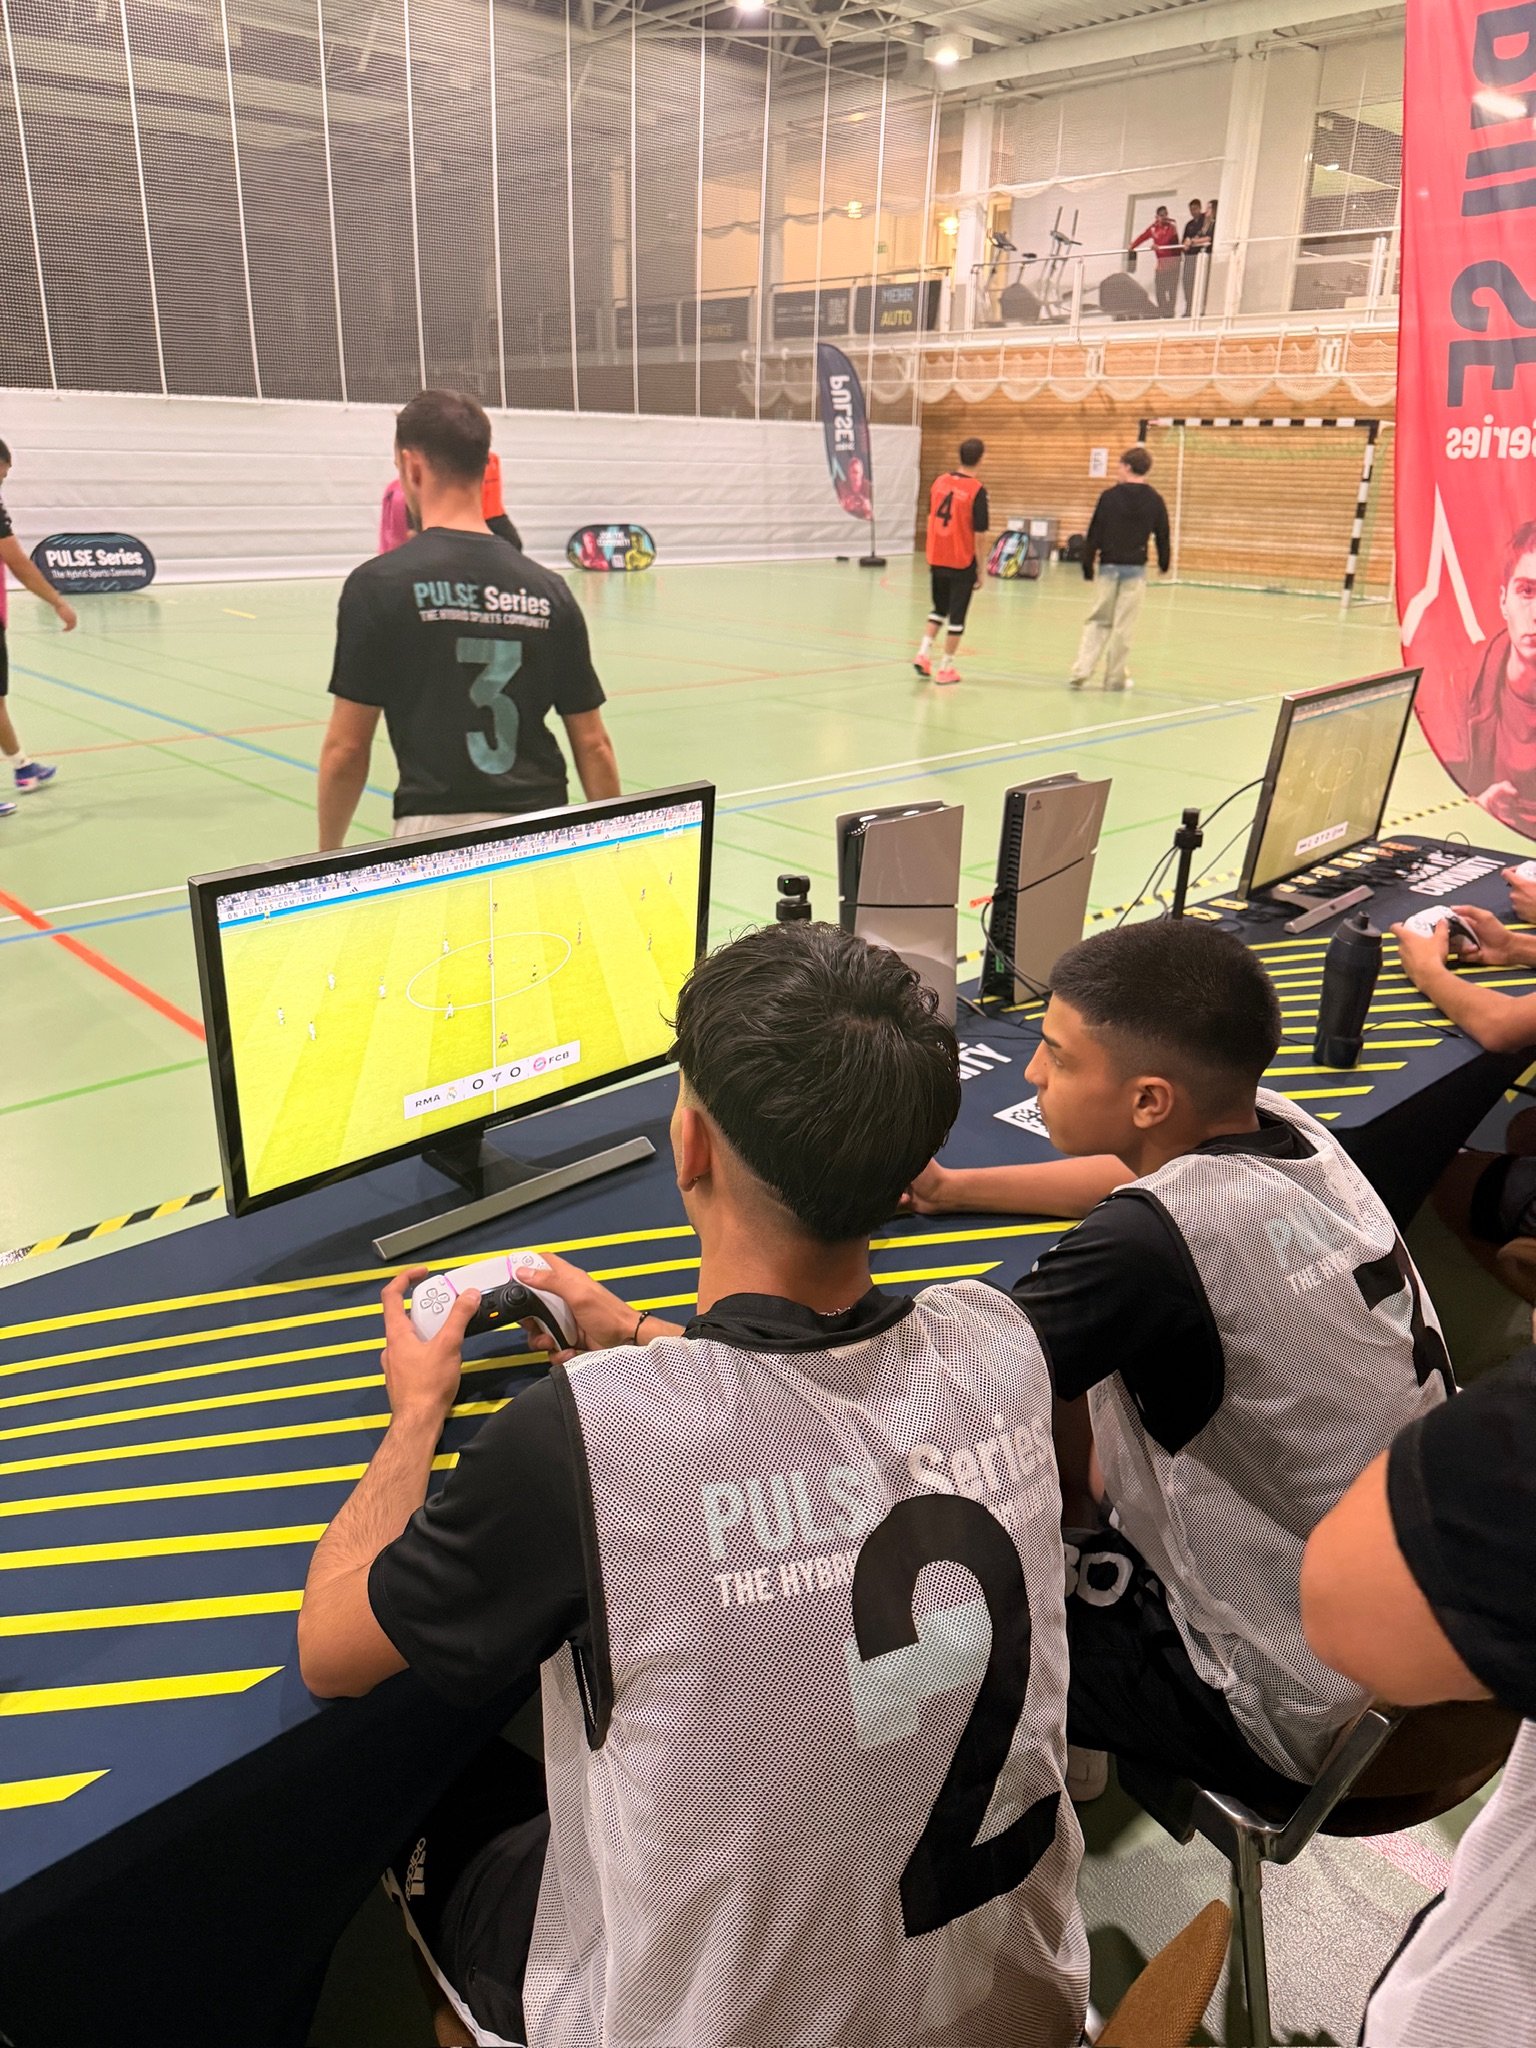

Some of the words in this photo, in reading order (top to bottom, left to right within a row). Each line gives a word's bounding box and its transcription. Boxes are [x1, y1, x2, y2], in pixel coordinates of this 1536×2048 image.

[880, 309, 913, 327] AUTO
[936, 491, 954, 527] 4
[45, 549, 96, 568] PULSE
[95, 548, 144, 566] Series
[413, 581, 481, 609] PULSE
[484, 586, 551, 616] Series
[456, 637, 522, 774] 3
[227, 911, 239, 920] ON
[415, 1094, 441, 1108] RMA
[548, 1051, 570, 1065] FCB
[1285, 1266, 1322, 1296] THE
[701, 1464, 868, 1562] PULS
[712, 1566, 774, 1608] THE
[851, 1493, 1062, 1939] 2
[405, 1837, 427, 1902] adidas
